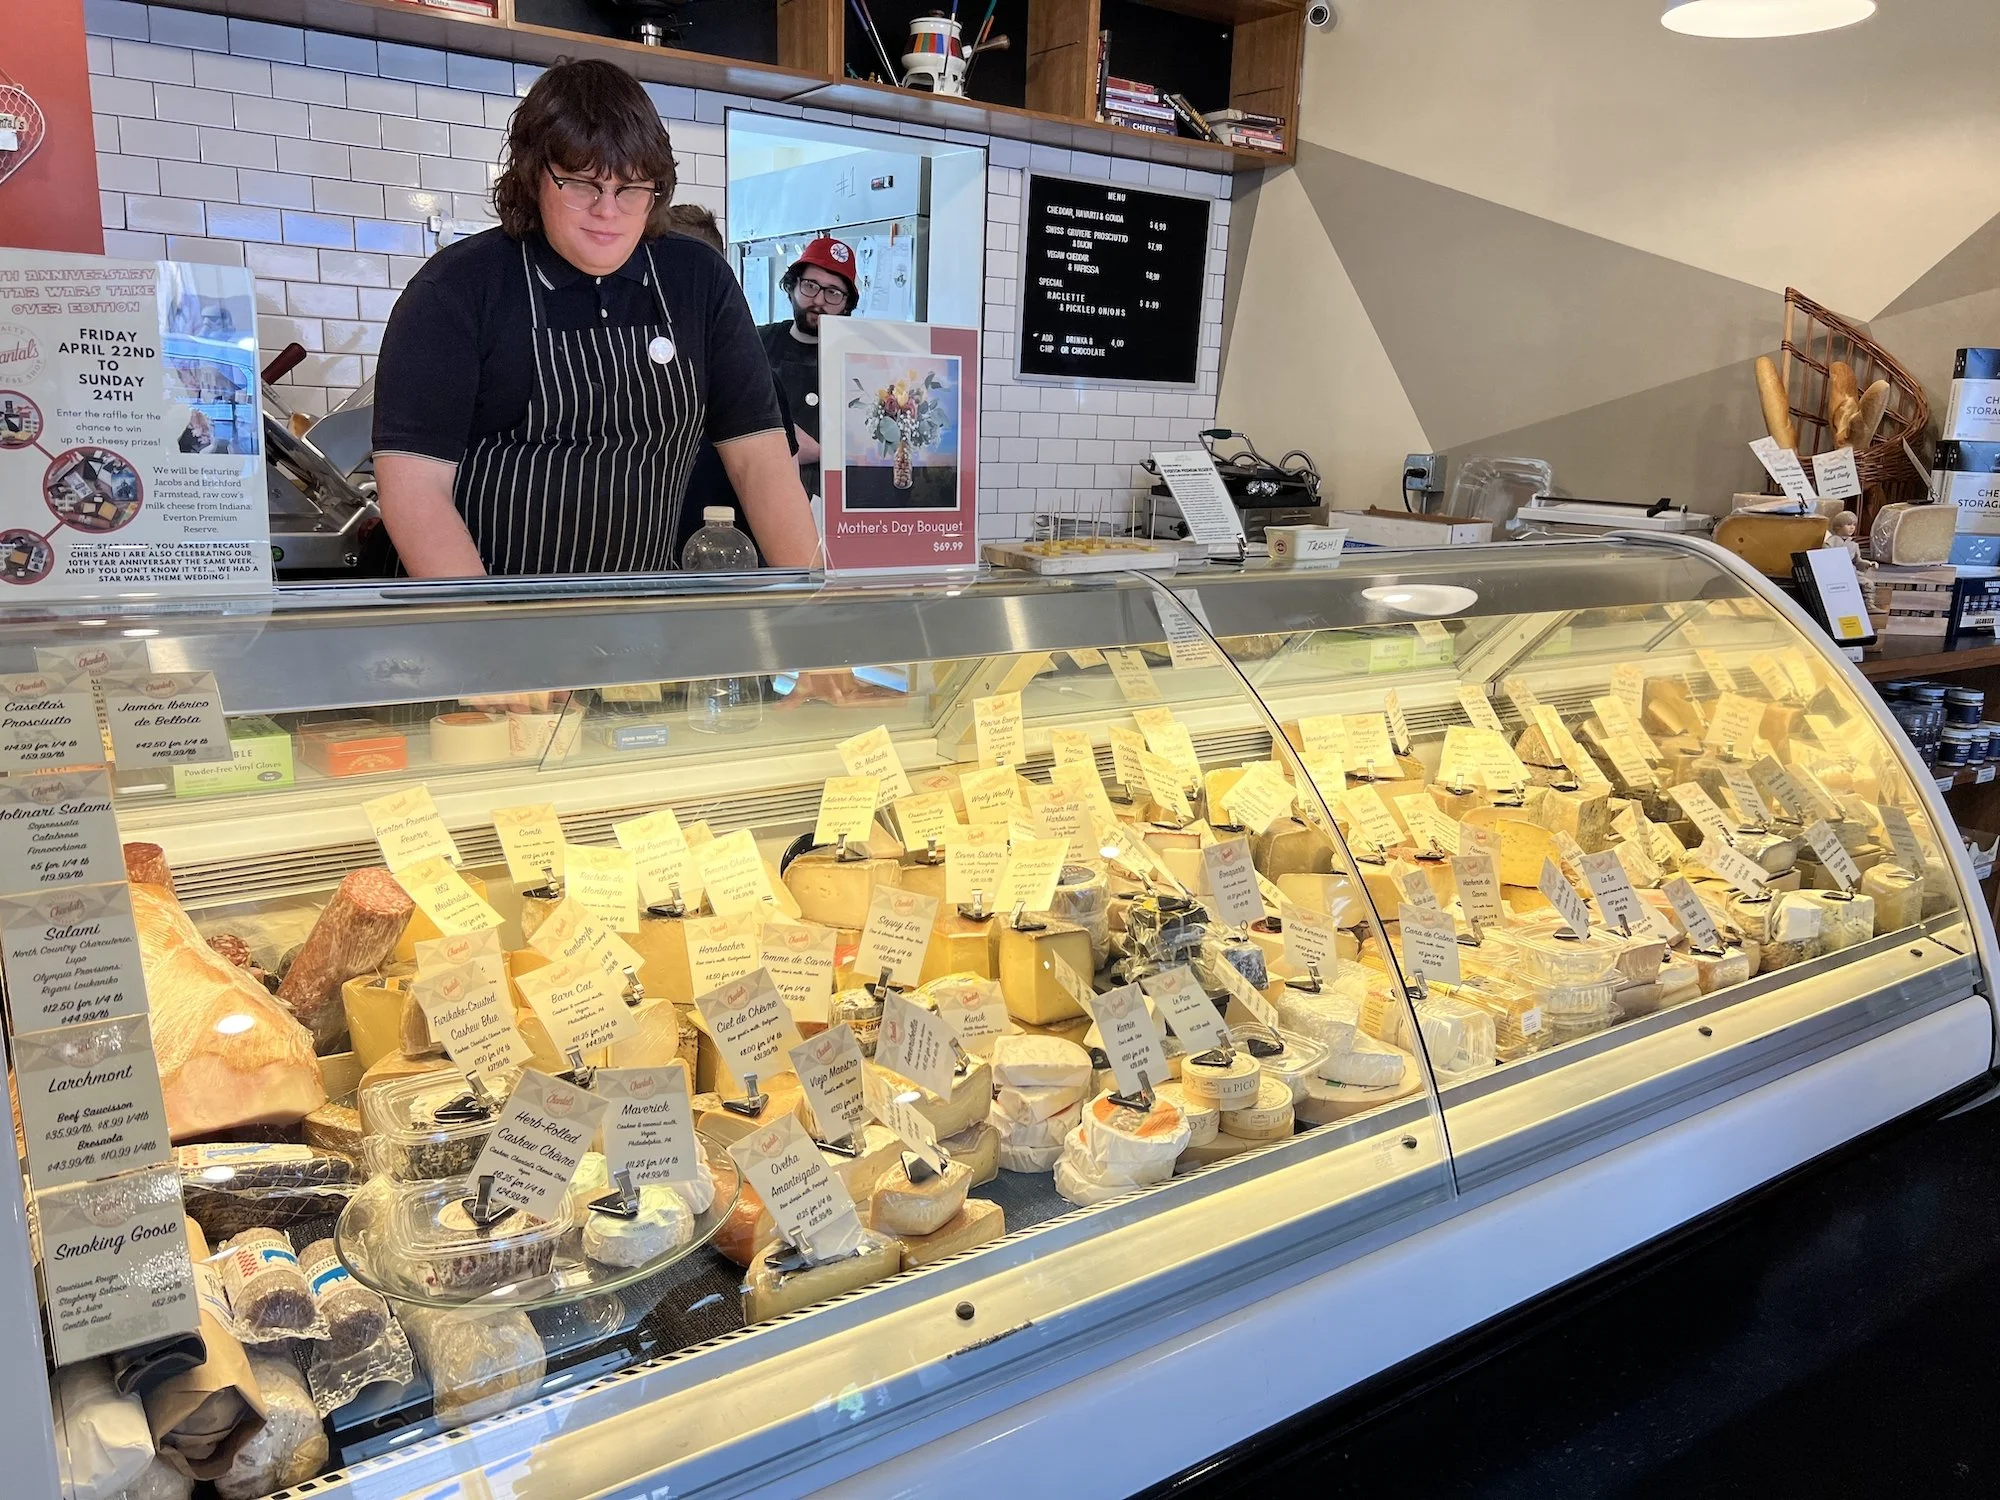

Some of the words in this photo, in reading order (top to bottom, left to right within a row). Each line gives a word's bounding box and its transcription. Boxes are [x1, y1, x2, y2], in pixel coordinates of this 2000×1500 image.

[1133, 123, 1156, 133] CHEESE
[1108, 192, 1126, 201] MENU
[1075, 209, 1099, 220] HAVARTI
[1105, 213, 1124, 223] GOUDA
[1045, 225, 1064, 235] SWISS
[1067, 228, 1092, 239] GRUYERE
[1094, 231, 1128, 243] PROSCIUTTO
[1072, 239, 1076, 247] &
[1077, 240, 1092, 249] DIJON
[1047, 249, 1065, 260] VEGAN
[1066, 252, 1089, 262] CHEDDAR
[25, 269, 156, 281] ANNIVERSARY
[1068, 263, 1072, 271] &
[1073, 263, 1099, 274] HARISSA
[1039, 277, 1063, 287] SPECIAL
[45, 286, 101, 297] WARS
[106, 285, 155, 296] TAKE
[1047, 291, 1085, 302] RACLETTE
[12, 303, 62, 315] OVER
[68, 301, 140, 314] EDITION
[1060, 303, 1064, 311] &
[1066, 304, 1096, 314] PICKLED
[1098, 307, 1126, 317] ONIONS
[80, 328, 137, 342] FRIDAY
[58, 342, 105, 356] APRIL
[111, 346, 155, 358] 22ND
[1060, 346, 1069, 354] OR
[1071, 347, 1105, 356] CHOCOLATE
[97, 360, 119, 371] TO
[79, 374, 144, 387] SUNDAY
[93, 389, 133, 401] 24TH
[56, 409, 81, 417] Enter
[85, 410, 100, 418] the
[103, 410, 128, 419] raffle
[131, 411, 143, 420] for
[147, 412, 161, 421] the
[76, 423, 111, 432] chance
[114, 424, 124, 432] to
[126, 424, 142, 432] win
[60, 438, 73, 447] up
[75, 436, 85, 444] to
[88, 436, 94, 444] 3
[96, 437, 128, 447] cheesy
[131, 438, 161, 448] prizes!
[153, 466, 169, 474] We
[170, 466, 187, 474] will
[189, 467, 199, 475] be
[153, 490, 200, 499] Farmstead,
[145, 502, 165, 510] milk
[167, 502, 195, 510] cheese
[1958, 499, 2000, 508] STORAG
[837, 520, 888, 535] Mother's
[892, 521, 914, 536] Day
[917, 520, 963, 535] Bouquet
[933, 542, 963, 552] $69.99
[1307, 539, 1339, 551] TRASH!
[4, 699, 66, 712] Casella's
[118, 701, 164, 713] Jamón
[167, 700, 209, 710] Ibérico
[1, 716, 72, 728] Prosciutto
[134, 717, 151, 727] de
[154, 715, 201, 725] Bellota
[988, 726, 1013, 735] Cheddar
[184, 767, 232, 776] Powder-Free
[235, 763, 253, 771] Vinyl
[256, 762, 281, 770] Gloves
[971, 792, 992, 804] Wooly
[58, 802, 112, 815] Salami
[1041, 805, 1064, 814] Jasper
[1065, 804, 1079, 812] Hill
[376, 822, 404, 836] Everton
[405, 811, 439, 827] Premium
[32, 832, 79, 842] Calabrese
[519, 828, 542, 837] Comté
[955, 850, 977, 860] Seven
[978, 850, 1003, 860] Sisters
[876, 915, 904, 931] Sappy
[904, 920, 921, 934] Ewe
[44, 924, 100, 942] Salami
[1404, 926, 1422, 937] Cana
[1435, 933, 1455, 944] Cabra
[12, 949, 37, 959] North
[40, 944, 77, 956] Country
[699, 941, 746, 955] Hornbacher
[761, 951, 788, 964] Tomme
[790, 953, 802, 964] de
[803, 954, 832, 968] Savoie
[551, 988, 575, 1004] Barn
[576, 981, 594, 995] Cat
[433, 993, 497, 1027] Furikake-Crusted
[716, 1016, 734, 1034] Ciel
[735, 1012, 747, 1027] de
[748, 998, 778, 1020] Chèvre
[964, 1012, 986, 1023] Kunik
[450, 1020, 480, 1040] Cashew
[481, 1014, 500, 1030] Blue
[48, 1065, 133, 1093] Larchmont
[810, 1068, 828, 1089] Viejo
[829, 1058, 858, 1078] Maestro
[629, 1078, 655, 1092] Chantal's
[1234, 1080, 1255, 1092] PICO
[57, 1110, 80, 1123] Beef
[83, 1102, 133, 1117] Saucisson
[621, 1102, 670, 1117] Maverick
[515, 1111, 584, 1145] Herb-Rolled
[77, 1133, 124, 1151] Bresaola
[497, 1127, 539, 1152] Cashew
[539, 1144, 576, 1168] Chèvre
[770, 1154, 800, 1176] Ovelha
[770, 1163, 820, 1198] Amanteigado
[53, 1233, 126, 1262] Smoking
[131, 1221, 178, 1242] Goose
